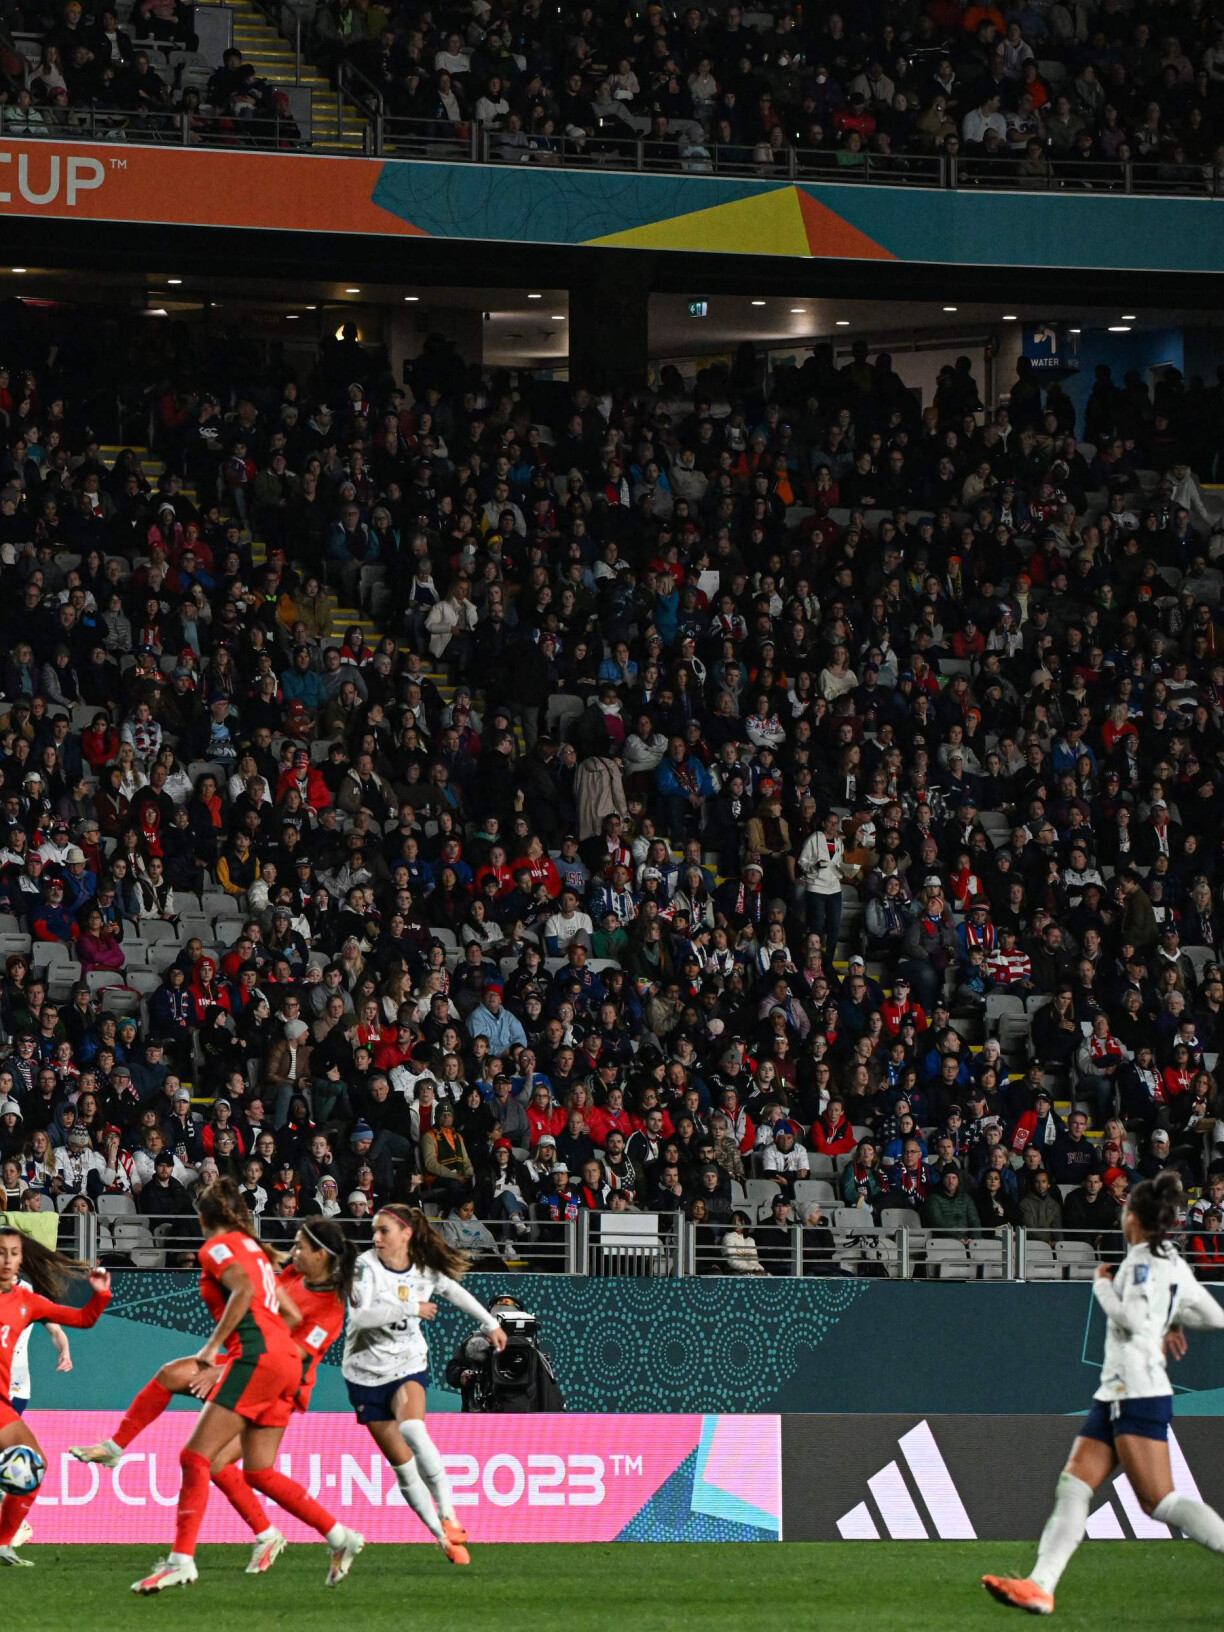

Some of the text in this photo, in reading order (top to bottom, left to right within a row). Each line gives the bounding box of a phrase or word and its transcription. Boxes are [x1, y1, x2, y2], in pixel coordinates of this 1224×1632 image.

[1030, 358, 1060, 367] WATER
[257, 1258, 280, 1315] 10
[1, 1324, 11, 1348] 2
